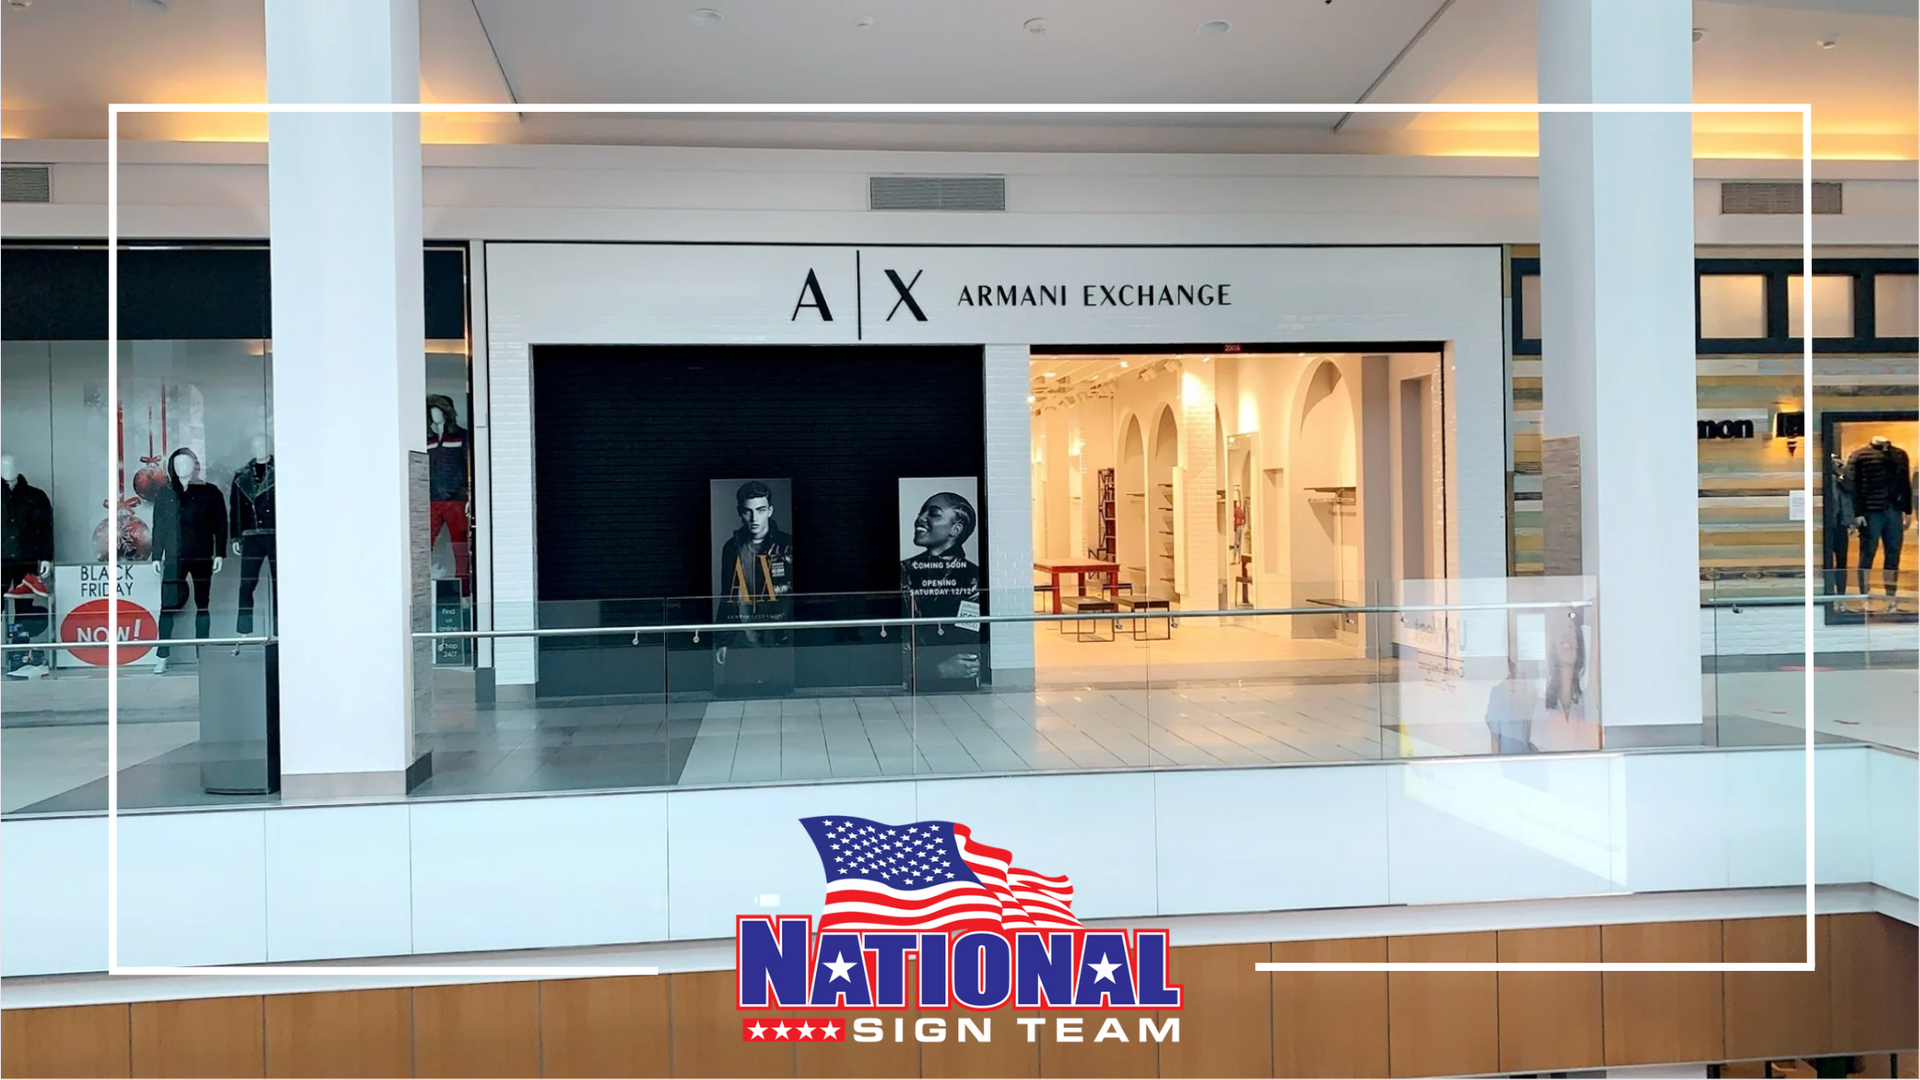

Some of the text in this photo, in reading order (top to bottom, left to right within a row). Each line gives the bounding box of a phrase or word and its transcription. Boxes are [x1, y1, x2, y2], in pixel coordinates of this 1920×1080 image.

[957, 284, 1232, 307] ARMANI EXCHANGE
[912, 561, 967, 570] COMING SOON
[922, 579, 957, 587] OPENING
[951, 588, 972, 596] 12/12
[76, 619, 142, 642] NOW!
